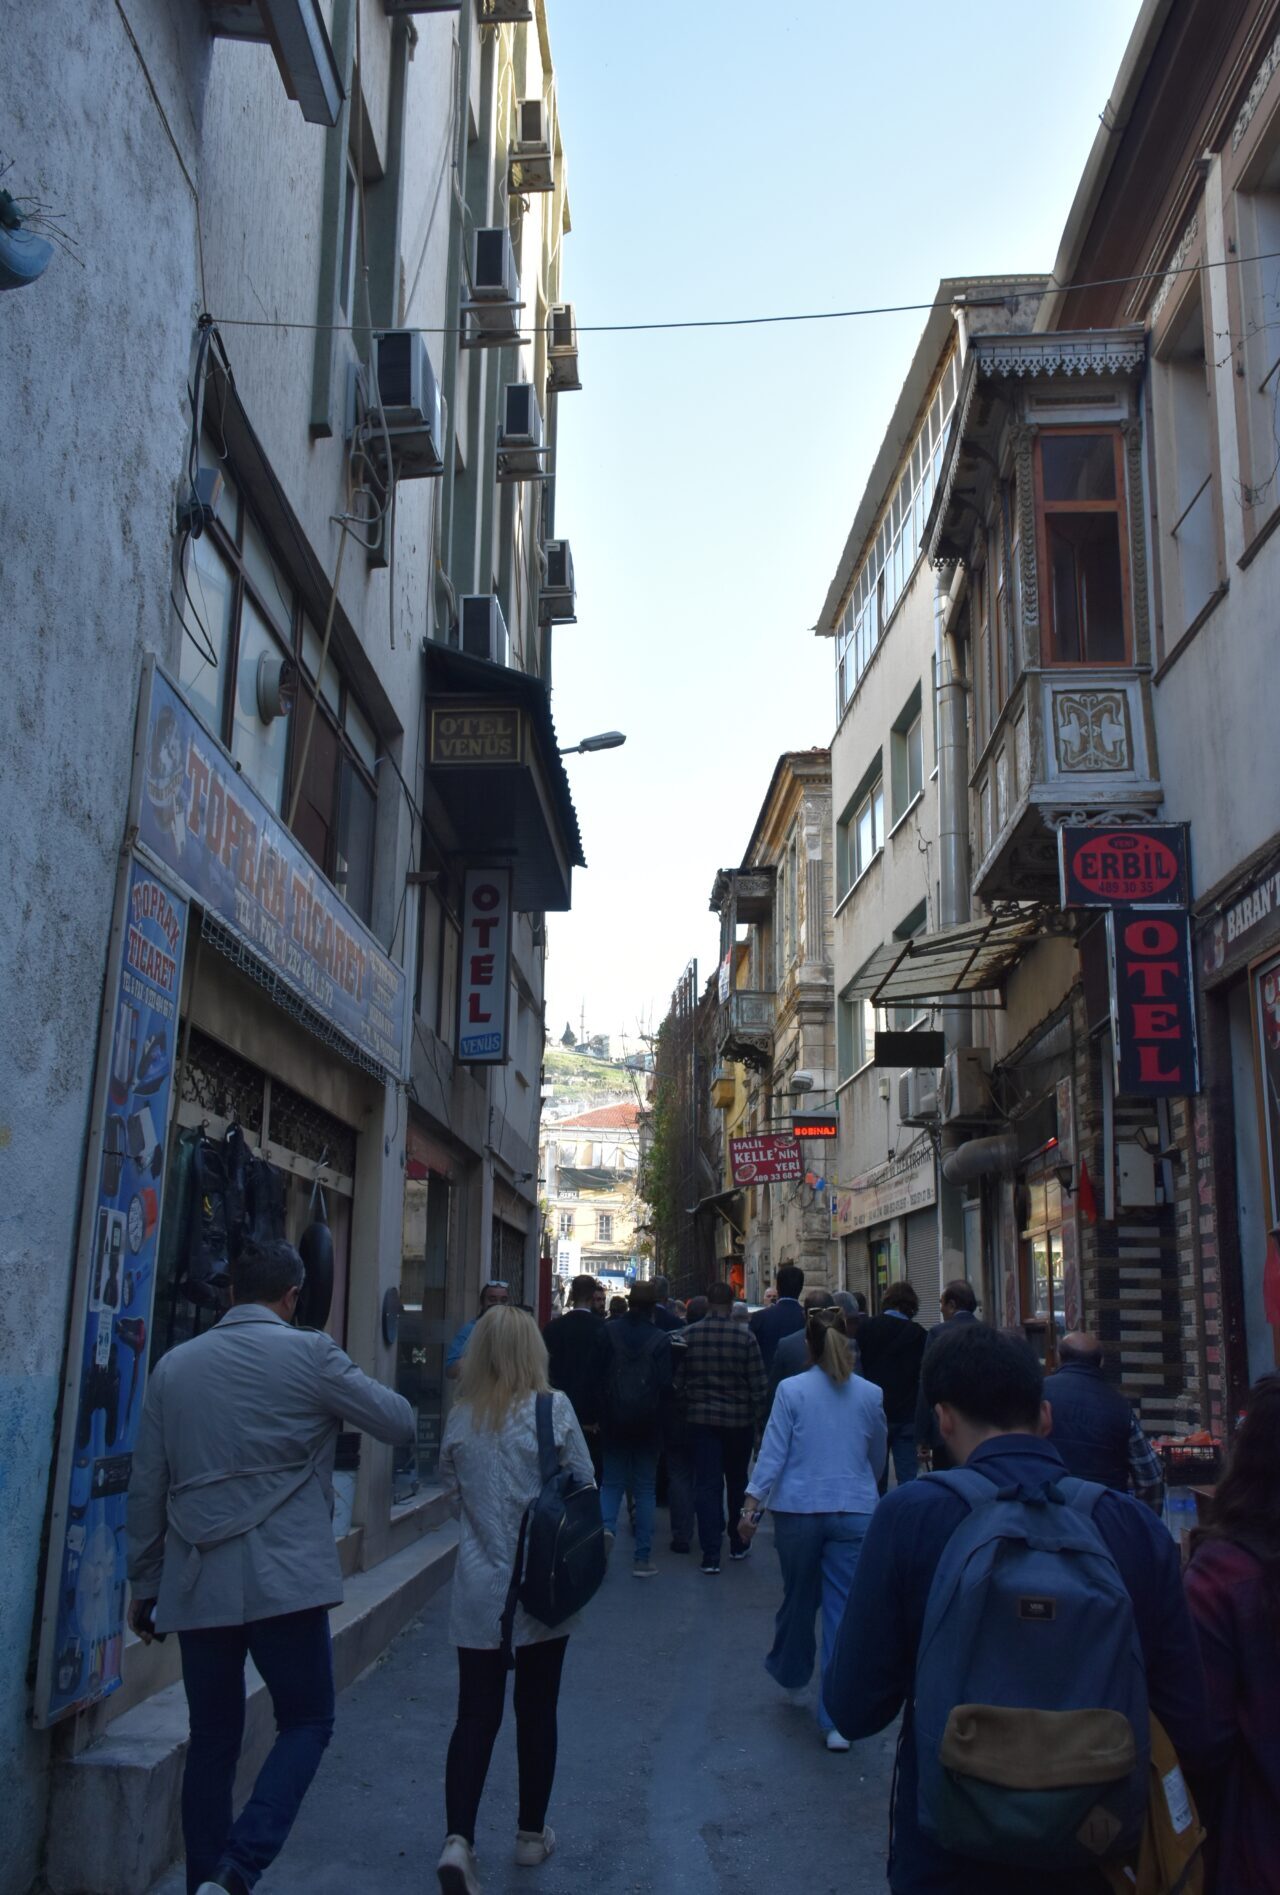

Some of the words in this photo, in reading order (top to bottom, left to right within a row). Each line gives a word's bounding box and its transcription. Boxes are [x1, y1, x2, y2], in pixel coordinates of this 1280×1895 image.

[439, 717, 513, 736] OTEL
[1079, 845, 1170, 879] ERBİL
[187, 742, 289, 926] TOPRAK
[290, 868, 367, 1003] TİCARET
[1098, 881, 1120, 893] 489
[1123, 881, 1137, 893] 30
[1140, 881, 1154, 893] 35
[131, 880, 181, 954] TOPRAK
[127, 922, 177, 993] TİCARET
[468, 883, 500, 1024] OTEL
[1124, 920, 1181, 1082] OTEL
[462, 1034, 500, 1054] VENÜS
[733, 1139, 764, 1150] HALİL
[734, 1148, 799, 1164] KELLE'NİN
[775, 1159, 801, 1171] YERİ
[625, 1267, 633, 1277] P
